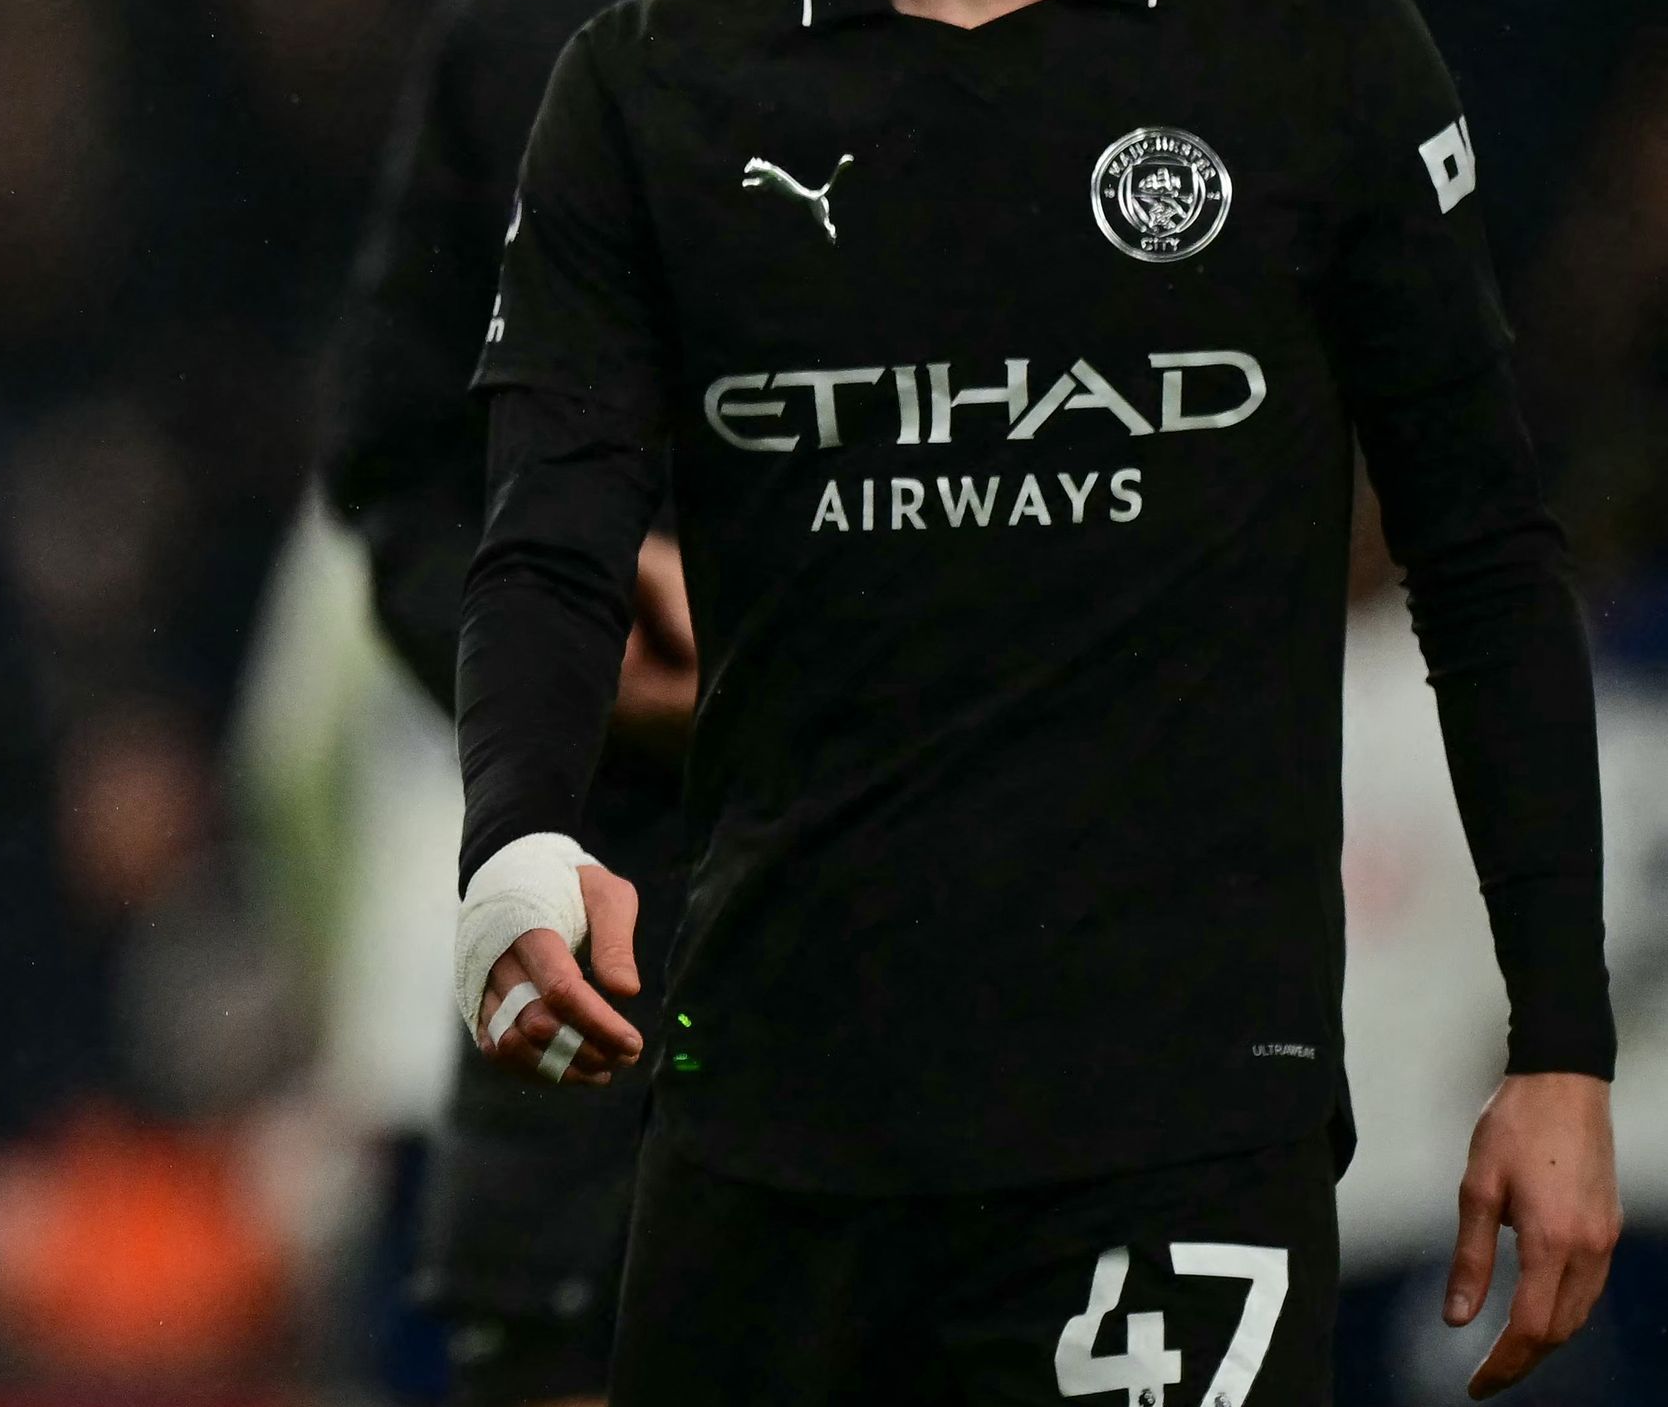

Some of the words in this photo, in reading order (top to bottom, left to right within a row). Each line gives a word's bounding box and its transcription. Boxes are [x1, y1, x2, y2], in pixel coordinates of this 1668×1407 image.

[1140, 237, 1181, 253] CITY
[703, 349, 1267, 453] ETIHAD
[810, 467, 1144, 532] AIRWAYS
[1054, 1242, 1290, 1407] 47
